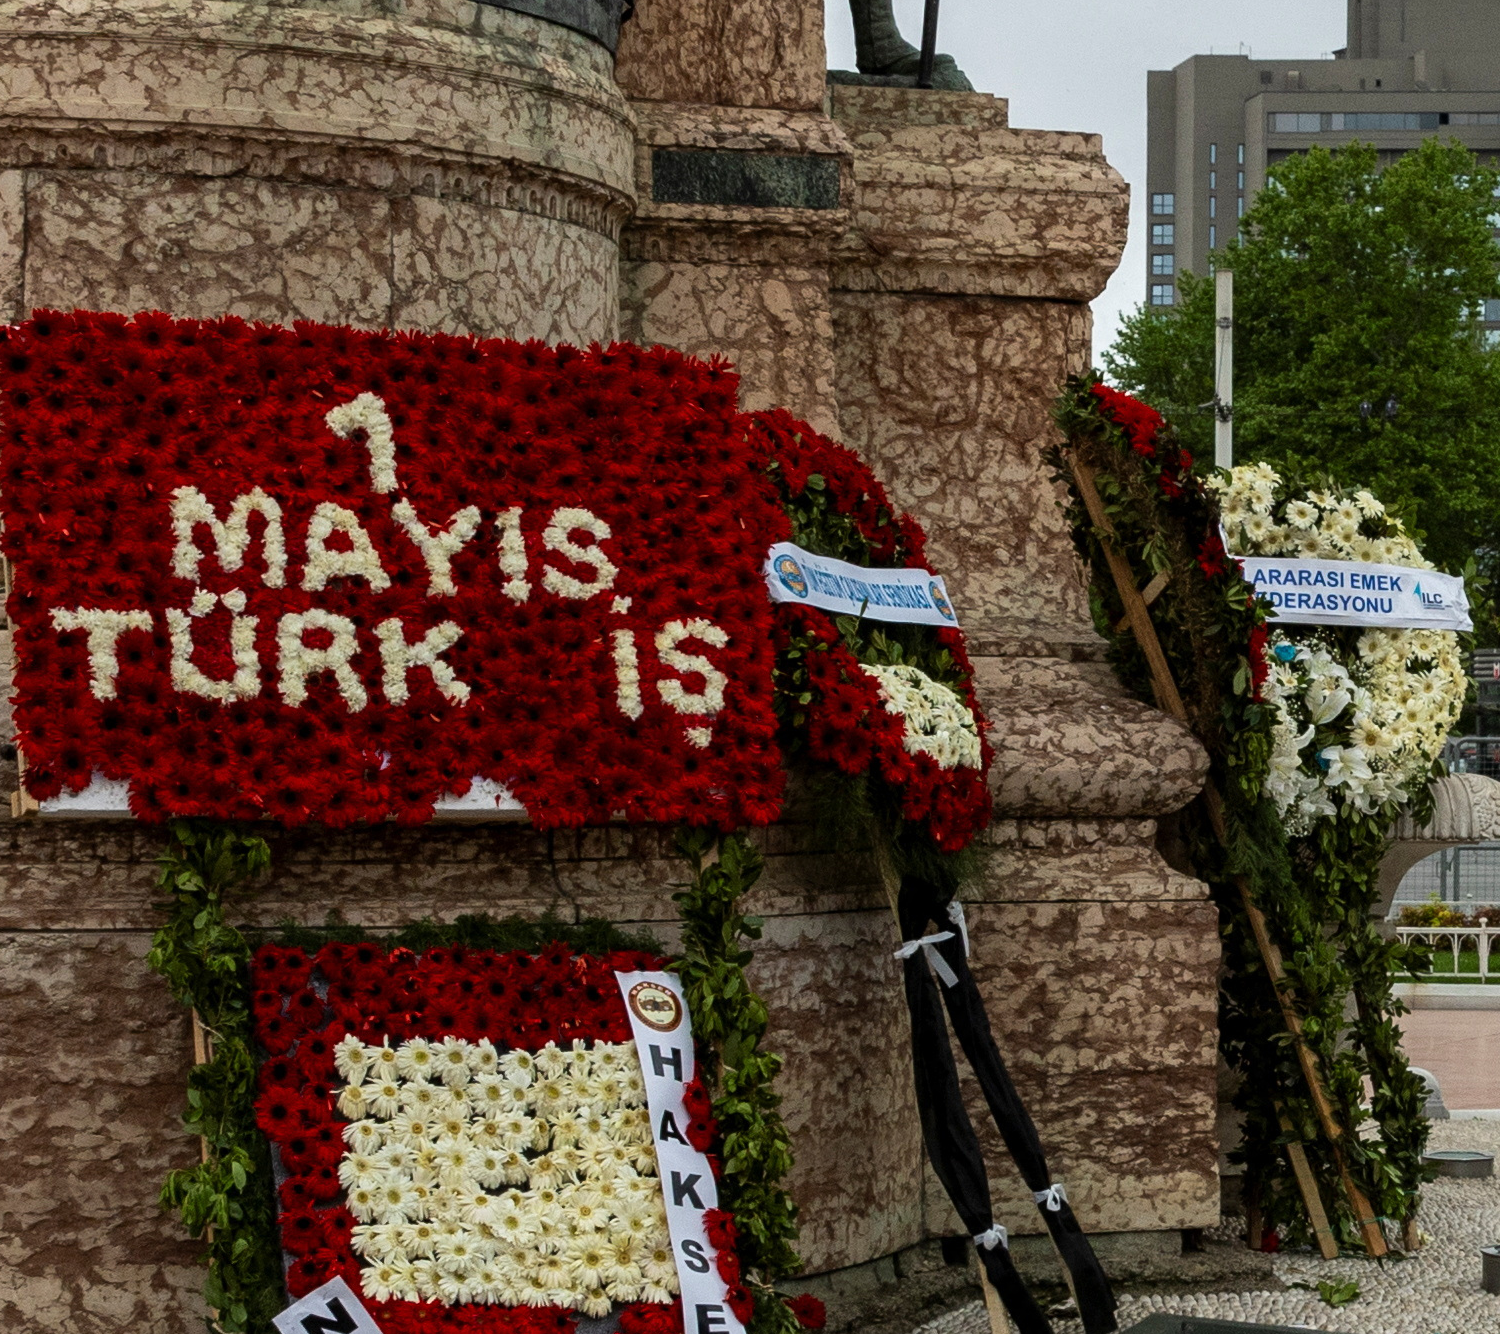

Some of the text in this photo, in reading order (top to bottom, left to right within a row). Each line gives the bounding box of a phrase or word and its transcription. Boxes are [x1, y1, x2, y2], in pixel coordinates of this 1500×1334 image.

[325, 391, 398, 494] 1
[169, 485, 620, 605] MAYIS
[1350, 573, 1403, 593] EMEK
[1421, 592, 1443, 604] ILC
[50, 588, 732, 749] TÜRK İŞ
